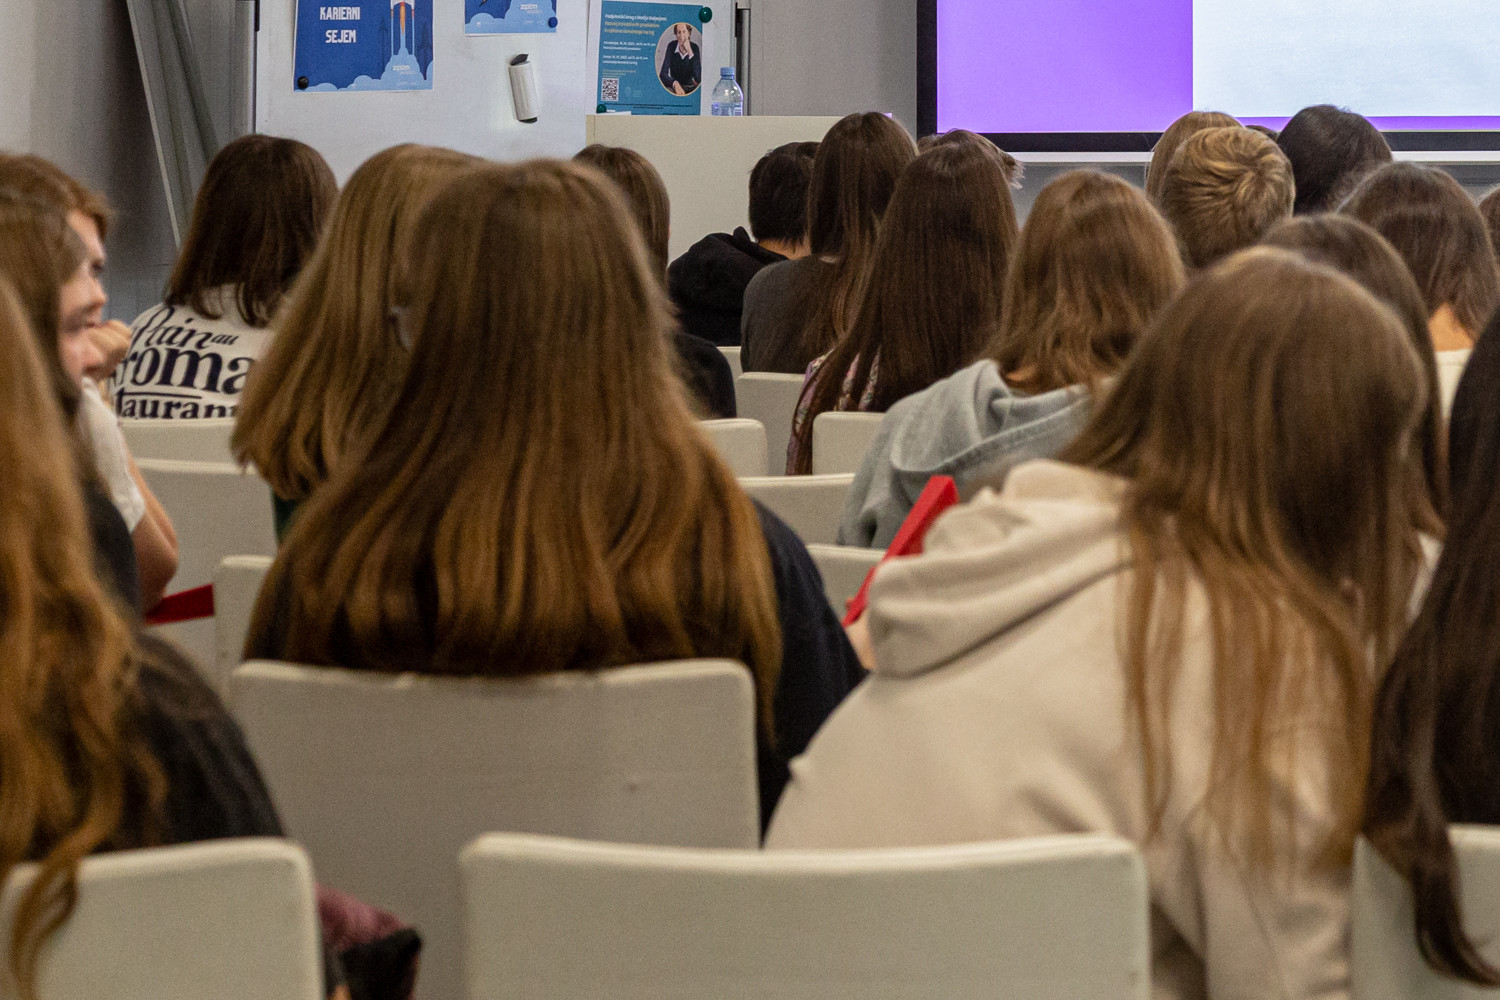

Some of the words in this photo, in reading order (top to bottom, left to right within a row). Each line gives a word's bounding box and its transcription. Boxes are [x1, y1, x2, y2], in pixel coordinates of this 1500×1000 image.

[319, 6, 361, 21] KARIERNI
[325, 29, 357, 43] SEJEM
[210, 333, 240, 346] au
